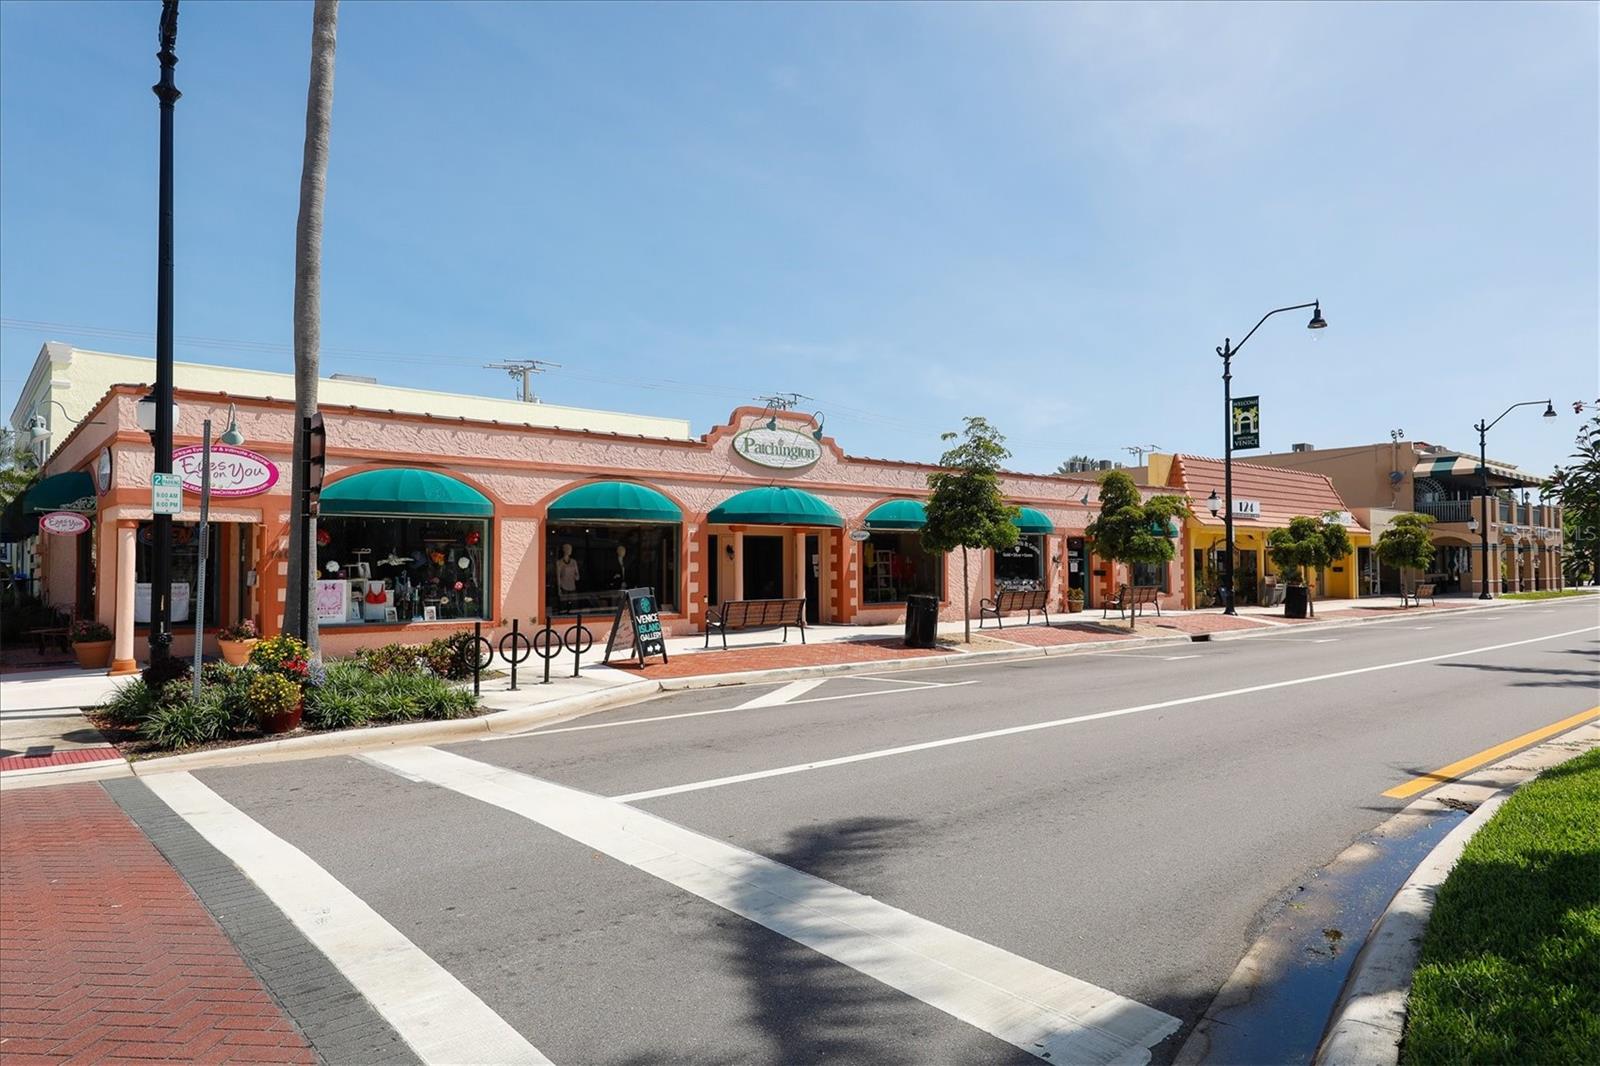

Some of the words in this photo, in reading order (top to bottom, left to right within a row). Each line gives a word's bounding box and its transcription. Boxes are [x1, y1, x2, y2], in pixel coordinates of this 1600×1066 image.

[743, 437, 815, 460] Patchington
[1234, 439, 1258, 447] VENICE
[213, 471, 227, 479] on
[227, 463, 264, 485] You
[154, 475, 162, 486] 2
[636, 613, 658, 624] VENICE
[639, 622, 661, 634] ISLAND
